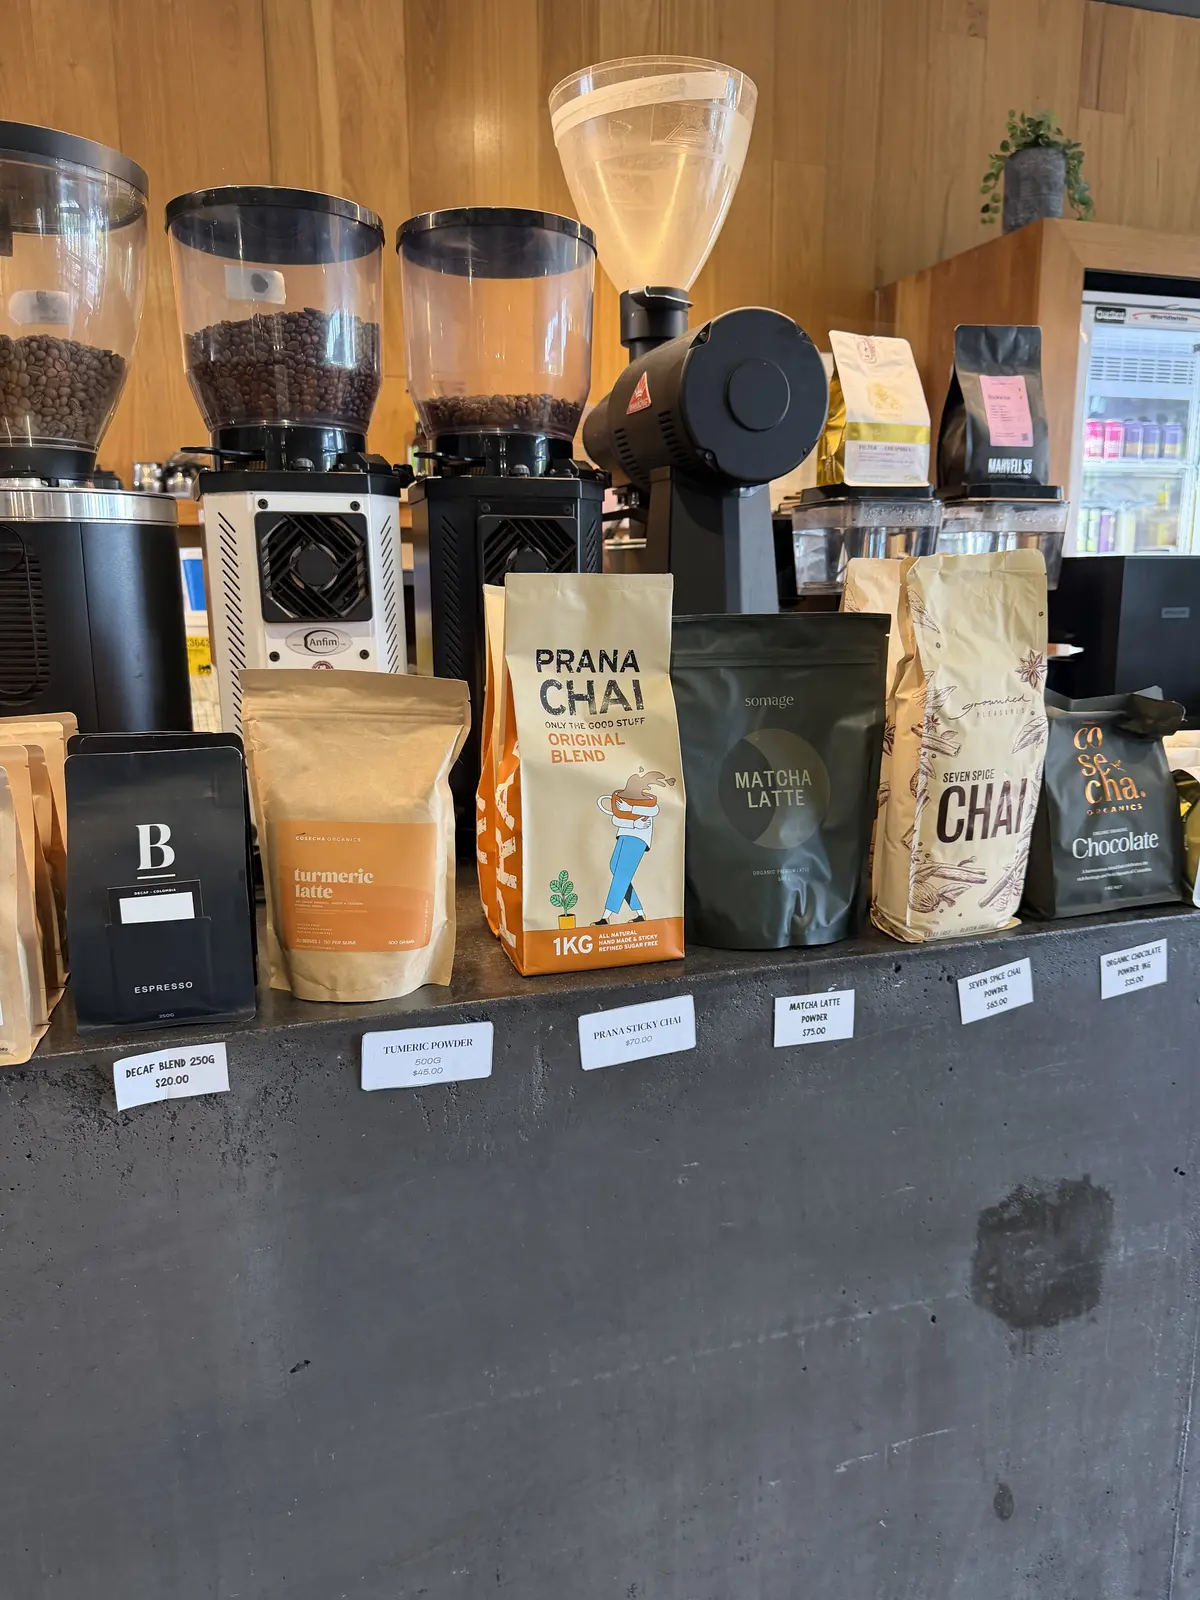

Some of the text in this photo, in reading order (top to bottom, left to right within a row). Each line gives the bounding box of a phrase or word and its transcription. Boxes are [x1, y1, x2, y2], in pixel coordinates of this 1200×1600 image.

[309, 637, 338, 647] Anfim
[535, 649, 641, 673] PRANA
[540, 678, 645, 716] CHAI
[744, 695, 794, 709] somage
[948, 693, 1031, 720] grounded
[544, 716, 646, 730] ONLY THE GOOD STUFF
[548, 732, 626, 747] ORIGINAL
[550, 749, 606, 764] BLEND
[734, 769, 812, 789] MATCHA
[942, 768, 996, 783] SEVEN SPICE
[747, 789, 805, 808] LATTE
[936, 777, 1028, 844] CHAI
[135, 823, 176, 871] B
[1072, 831, 1159, 859] Chocolate
[294, 868, 374, 884] turmeric
[295, 883, 334, 899] latte
[598, 938, 616, 946] HAND
[638, 933, 658, 942] STICKY
[611, 930, 638, 938] NATURAL
[552, 934, 594, 957] 1KG
[598, 940, 659, 952] REFINED SUGAR FREE
[1131, 945, 1162, 961] CHOCOLATE
[1117, 964, 1140, 976] POWDER
[968, 967, 1021, 990] SEVEN SPICE CHAI
[134, 981, 193, 994] ESPRESSO
[984, 984, 1009, 998] POWDER
[788, 997, 841, 1011] MATCHA LATTE
[801, 1013, 828, 1023] POWDER
[593, 1015, 682, 1040] PRANA STICKY CHAI
[802, 1026, 826, 1037] $75.00
[383, 1038, 473, 1055] TUMERIC POWDER
[625, 1035, 653, 1047] $70.00
[125, 1054, 215, 1079] DECAF BLEND 250G
[414, 1056, 442, 1066] 500G
[412, 1067, 444, 1077] $45.00
[155, 1074, 190, 1088] $20.00
